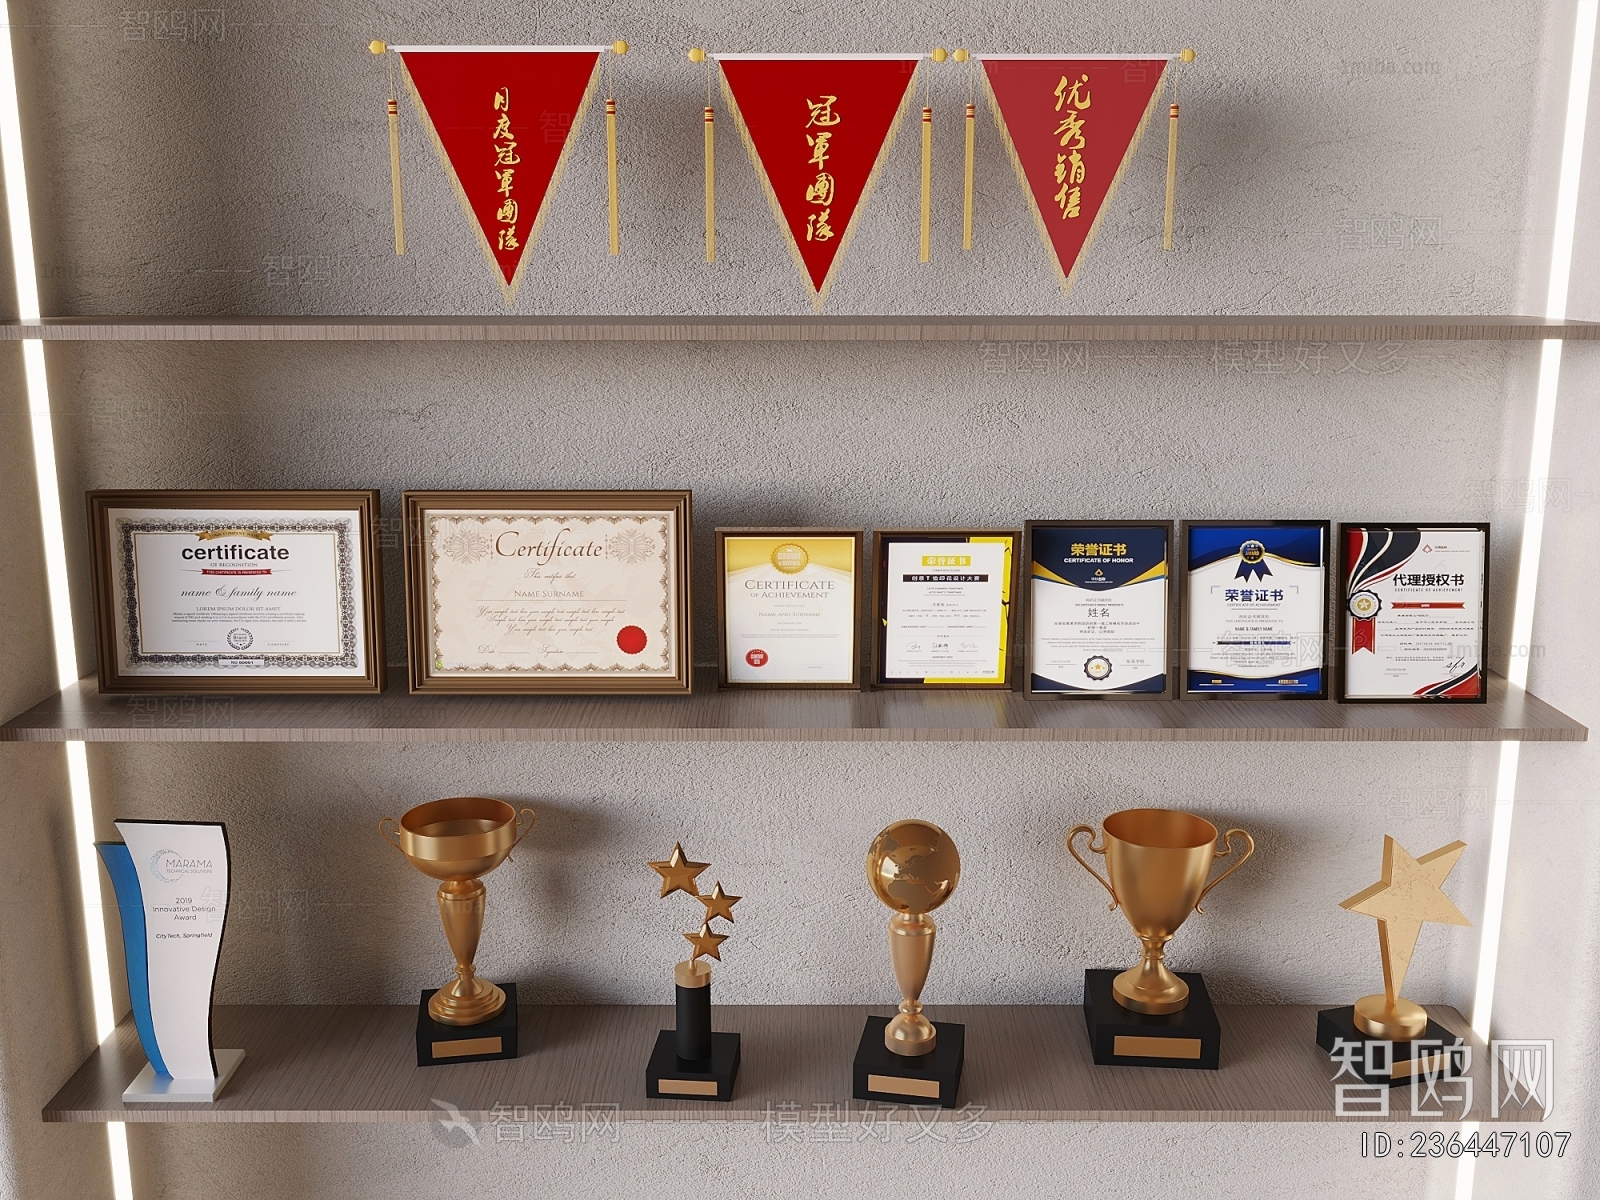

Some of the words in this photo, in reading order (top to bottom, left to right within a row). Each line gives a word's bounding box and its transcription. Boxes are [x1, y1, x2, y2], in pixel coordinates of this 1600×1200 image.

[181, 544, 290, 561] certificate
[495, 528, 603, 566] Certificate
[1070, 543, 1127, 557] 荣誉证书
[524, 568, 540, 579] This
[565, 571, 576, 579] that
[744, 579, 835, 590] CERTIFICATE
[1392, 574, 1465, 587] 代理授权书
[215, 584, 229, 598] &
[224, 586, 263, 602] family
[1225, 589, 1284, 602] 荣誉证书
[1087, 608, 1110, 618] 姓名
[166, 859, 213, 868] MARAMA
[192, 906, 216, 914] Design
[183, 932, 213, 940] Springfield
